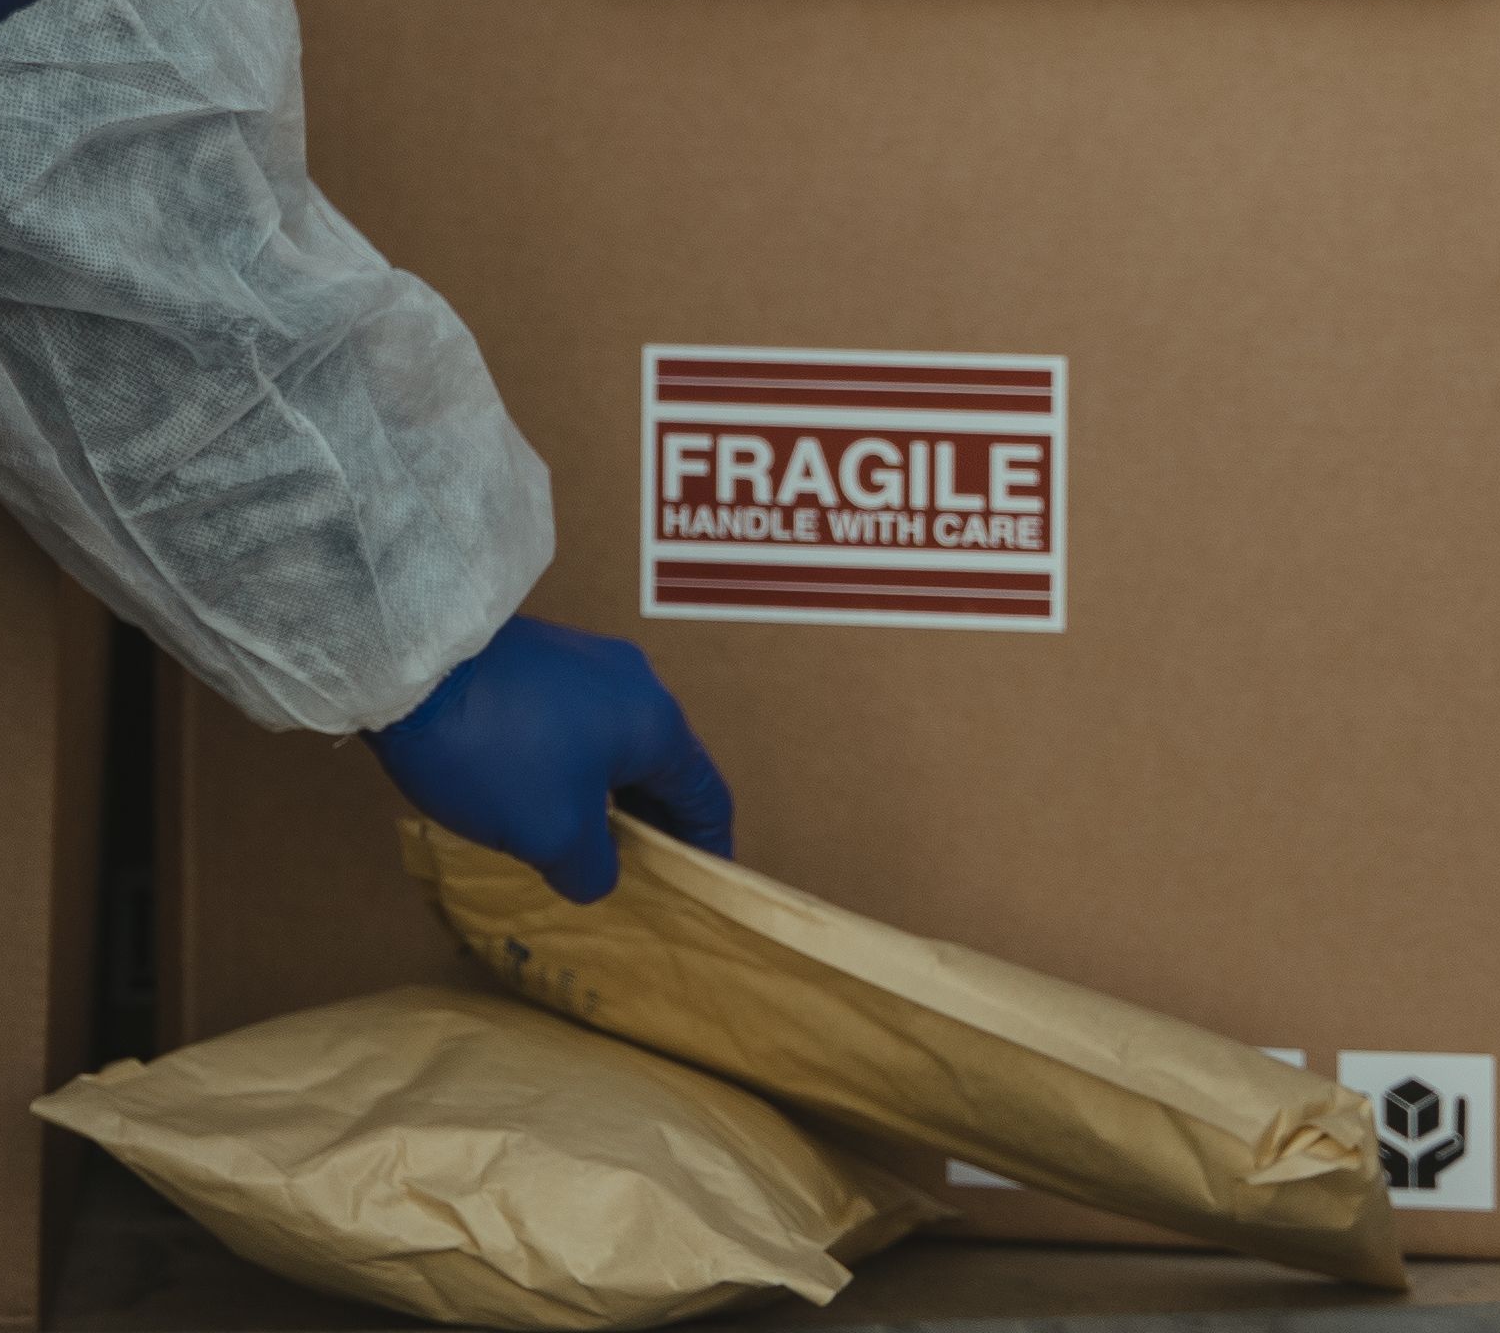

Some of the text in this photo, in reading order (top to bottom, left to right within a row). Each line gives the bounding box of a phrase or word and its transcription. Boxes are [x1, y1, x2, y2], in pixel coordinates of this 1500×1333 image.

[662, 432, 1044, 514] FRAGILE
[662, 504, 1044, 550] HANDLE WITH CARE
